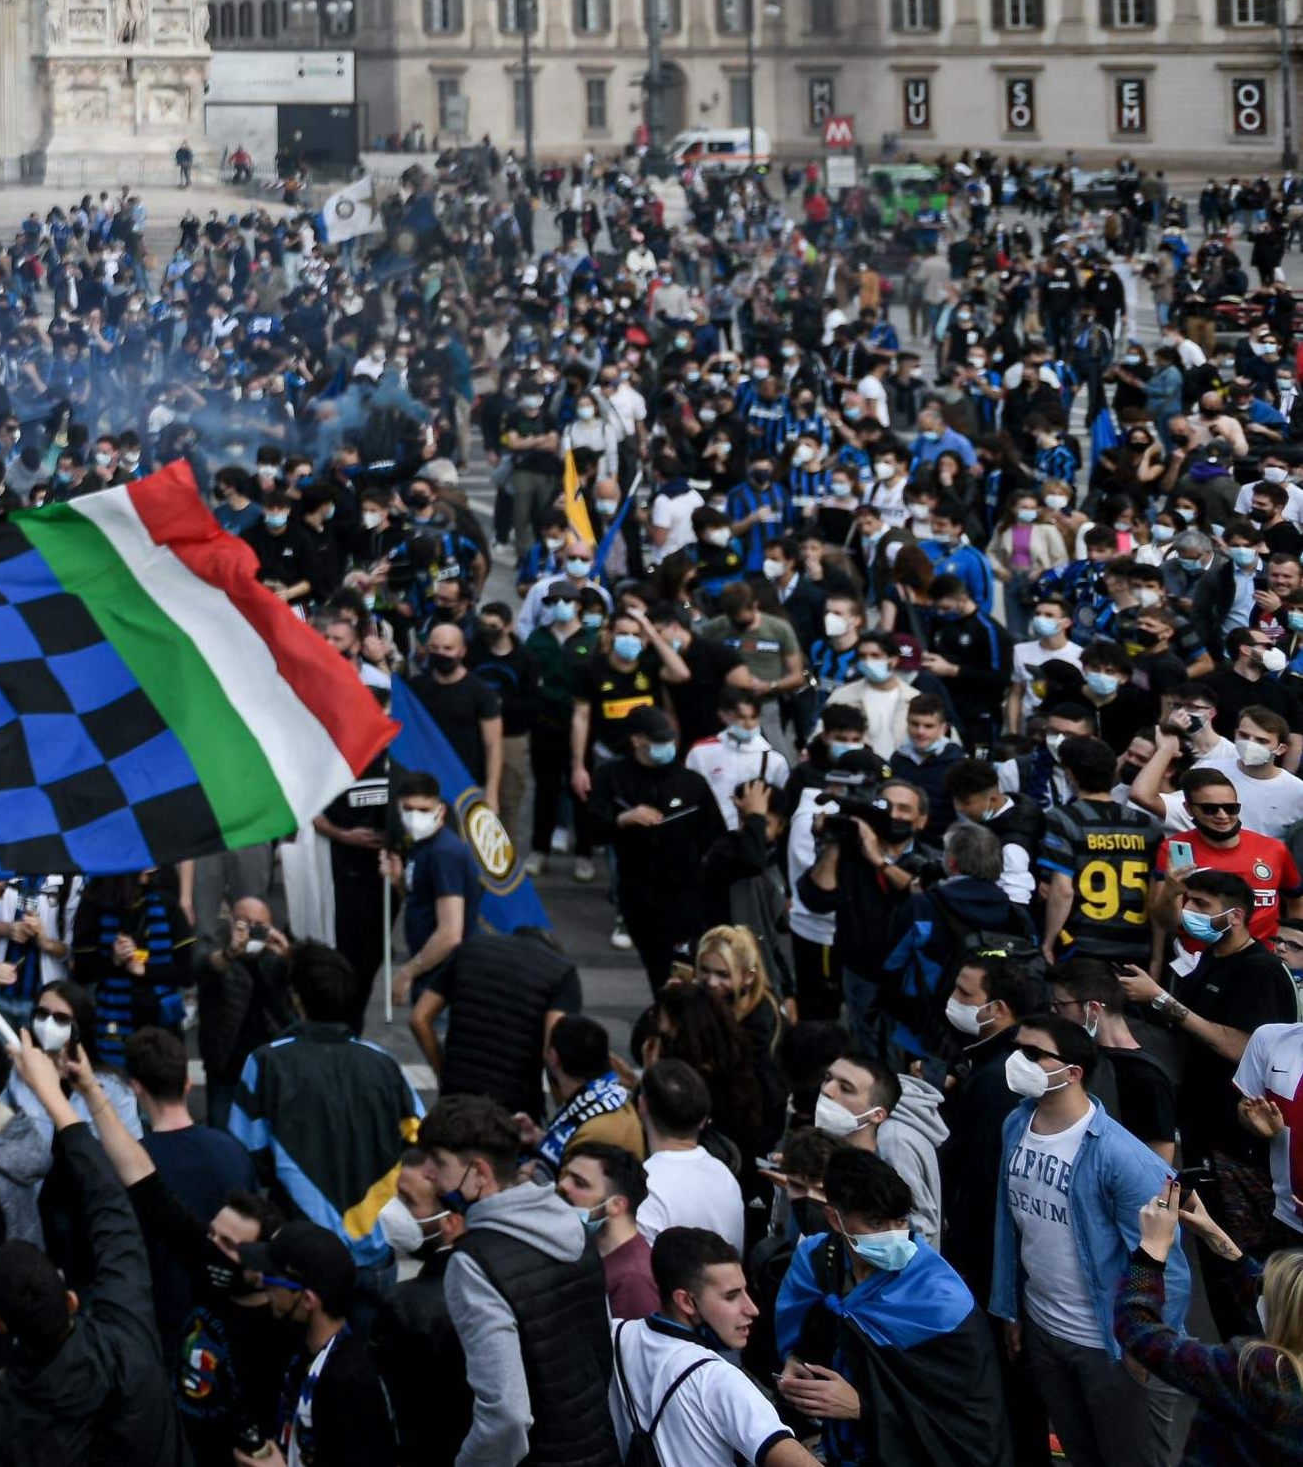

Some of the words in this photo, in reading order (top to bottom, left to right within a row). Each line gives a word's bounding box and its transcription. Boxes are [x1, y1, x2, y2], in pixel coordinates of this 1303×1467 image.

[825, 121, 852, 143] M
[1088, 833, 1145, 850] BASTONI
[1079, 860, 1148, 925] 95
[1009, 1189, 1069, 1226] DENIM
